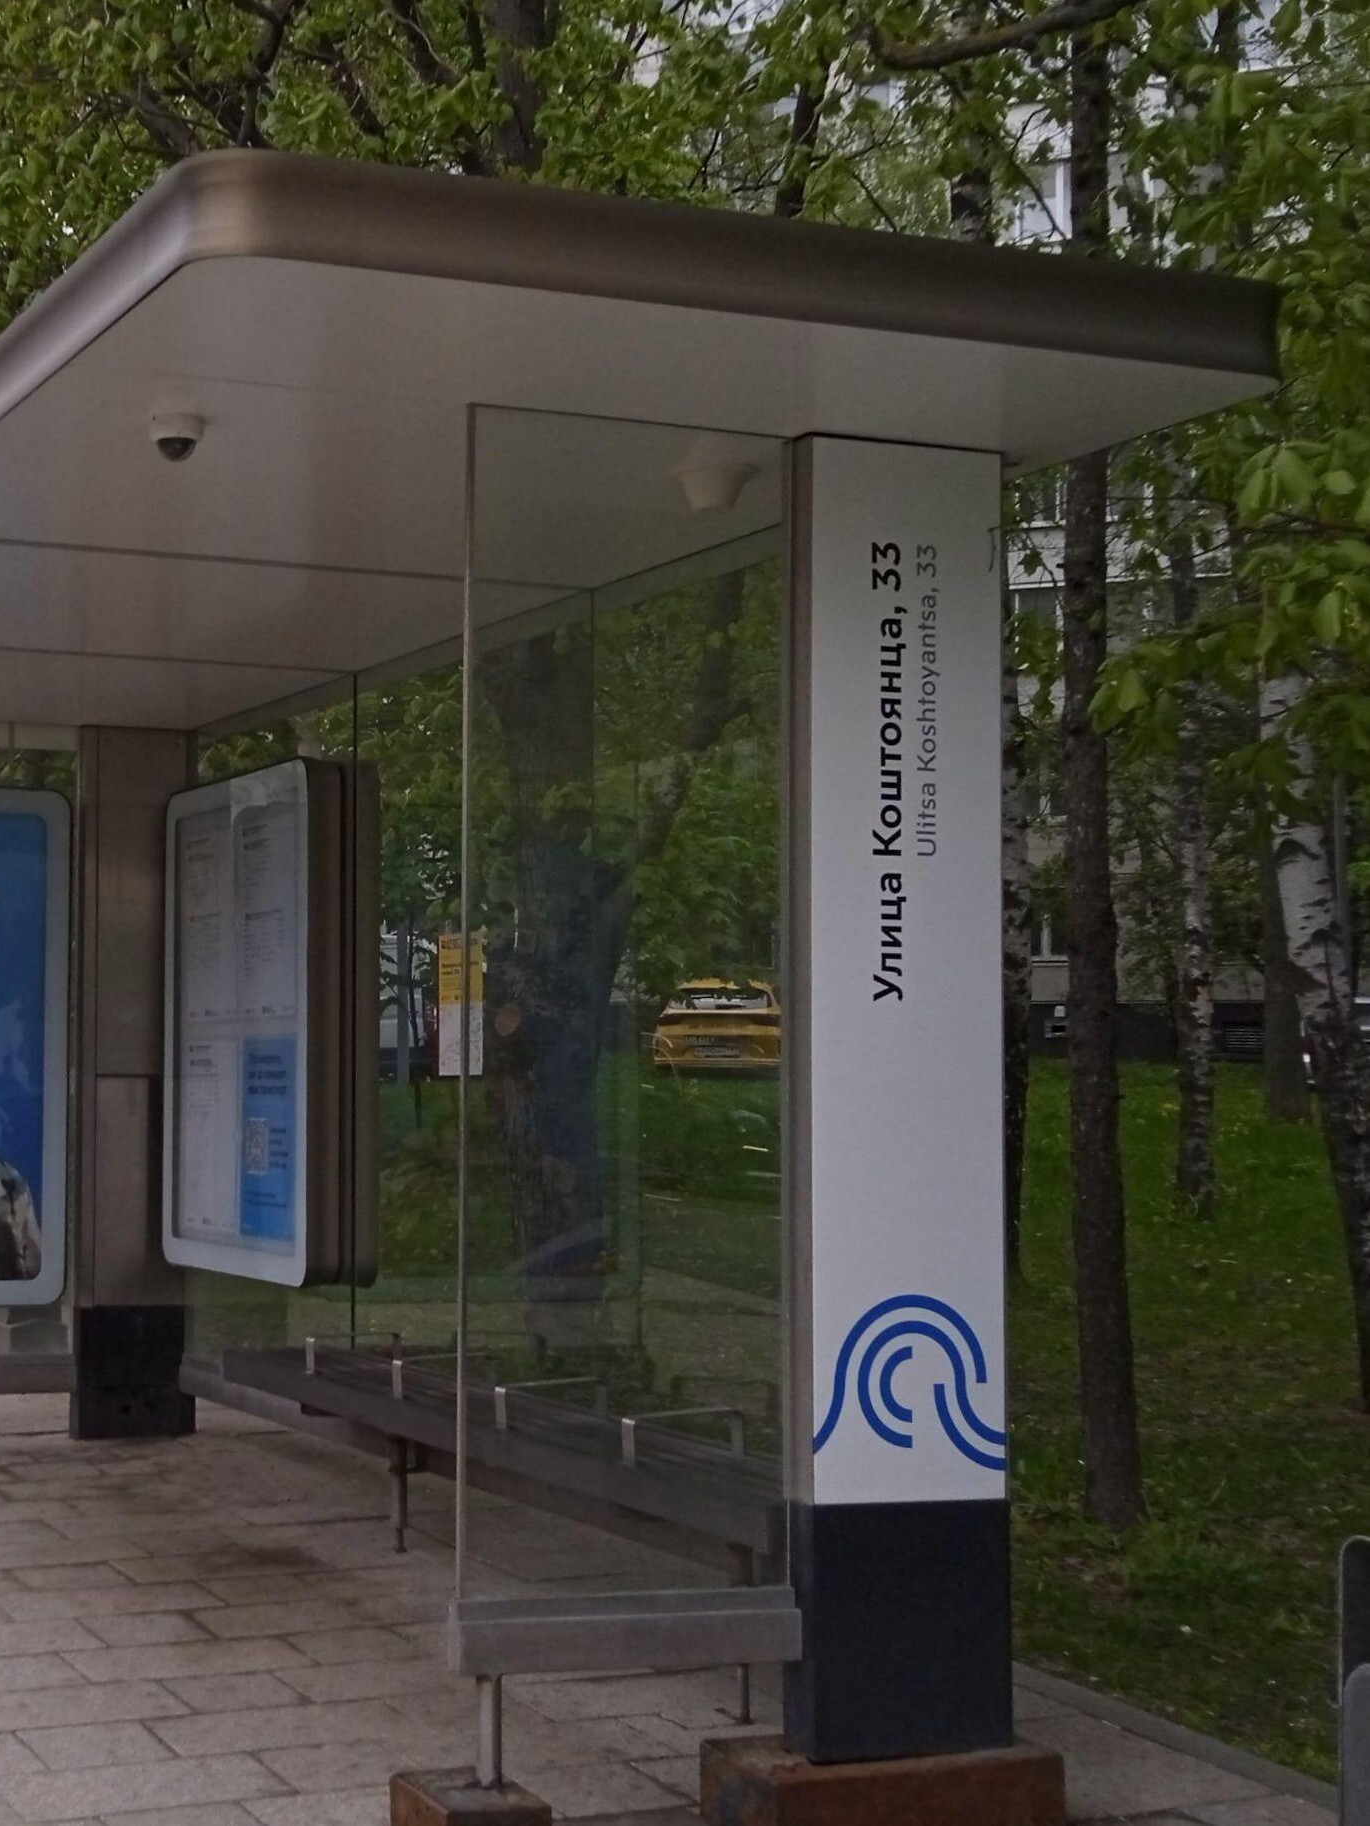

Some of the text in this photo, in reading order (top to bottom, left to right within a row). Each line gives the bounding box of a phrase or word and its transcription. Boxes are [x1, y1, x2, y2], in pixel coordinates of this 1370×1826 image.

[871, 541, 909, 1002] Улица Коштоянца, 33
[915, 543, 941, 857] Ulitsa Koshtoyantsa, 33
